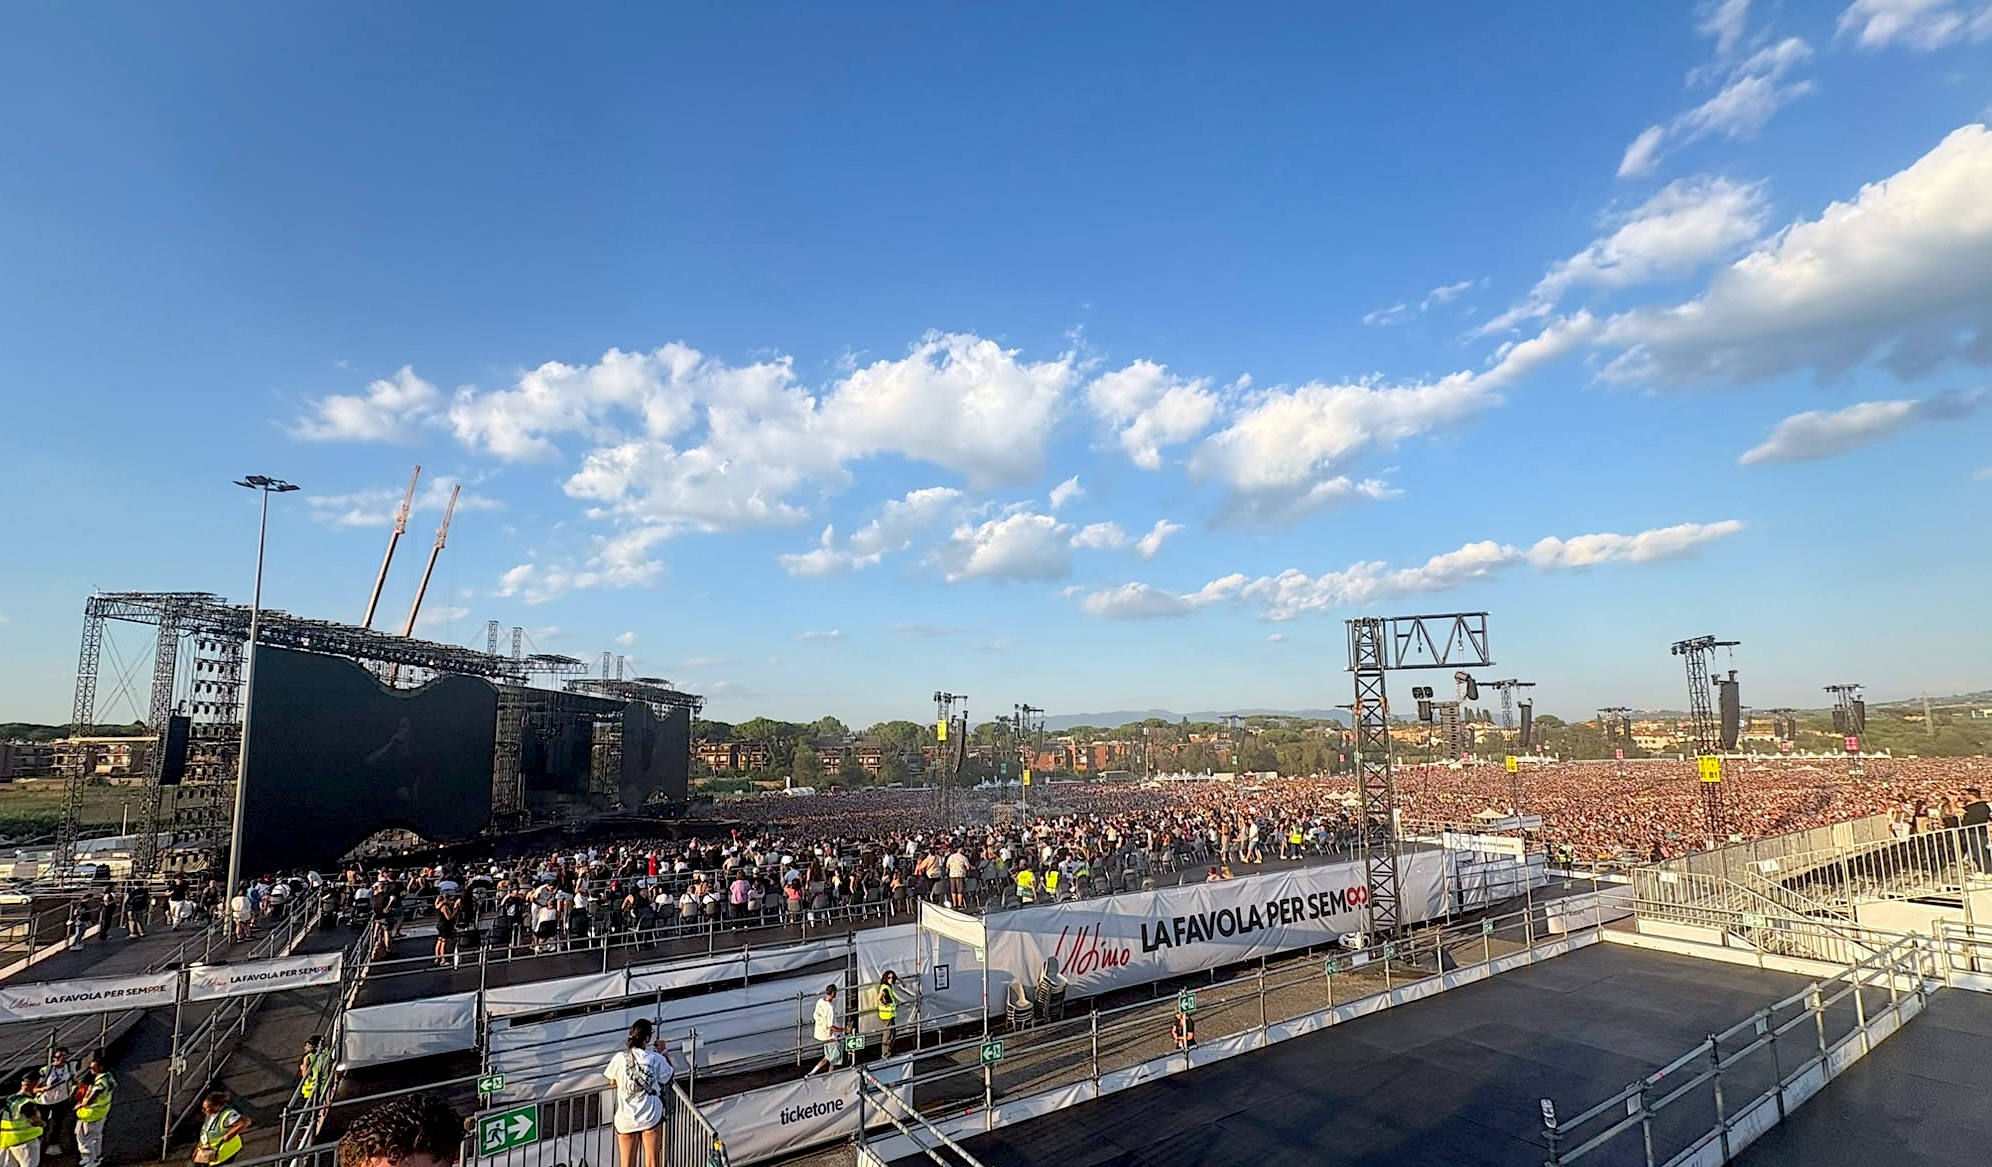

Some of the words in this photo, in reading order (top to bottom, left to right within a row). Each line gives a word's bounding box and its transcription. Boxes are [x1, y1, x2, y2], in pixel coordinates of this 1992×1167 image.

[1054, 922, 1130, 975] Ultimo
[1140, 920, 1173, 953] LA
[1173, 904, 1264, 947] FAVOLA
[1266, 896, 1305, 928] PER
[242, 972, 279, 982] FAVOLA
[280, 969, 297, 978] PER
[298, 965, 333, 975] SEMPRE
[45, 996, 58, 1004] LA
[60, 992, 102, 1003] FAVOLA
[104, 989, 124, 999] PER
[126, 984, 167, 996] SEMPRE
[780, 1099, 844, 1125] ticketone
